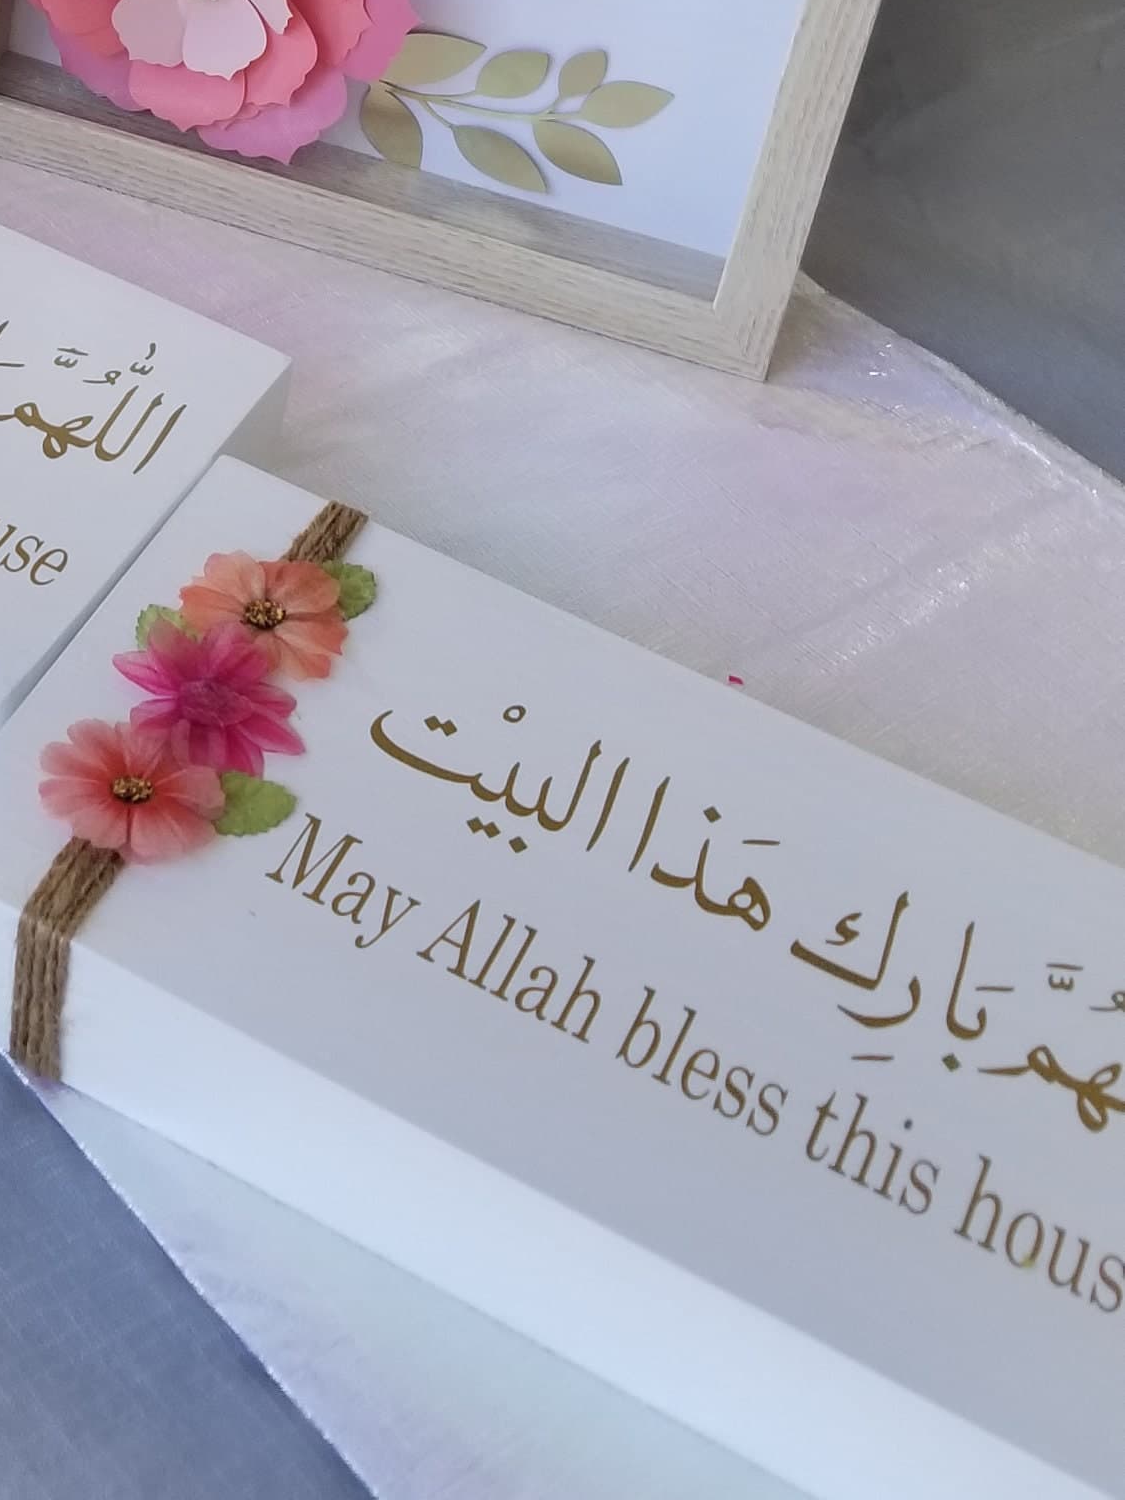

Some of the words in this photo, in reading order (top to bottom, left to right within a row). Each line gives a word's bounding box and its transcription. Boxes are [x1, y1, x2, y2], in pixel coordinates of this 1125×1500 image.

[264, 812, 422, 949] May
[415, 898, 603, 1044] Allah
[615, 984, 790, 1137] bless
[803, 1090, 942, 1216] this
[952, 1153, 1125, 1314] hous
